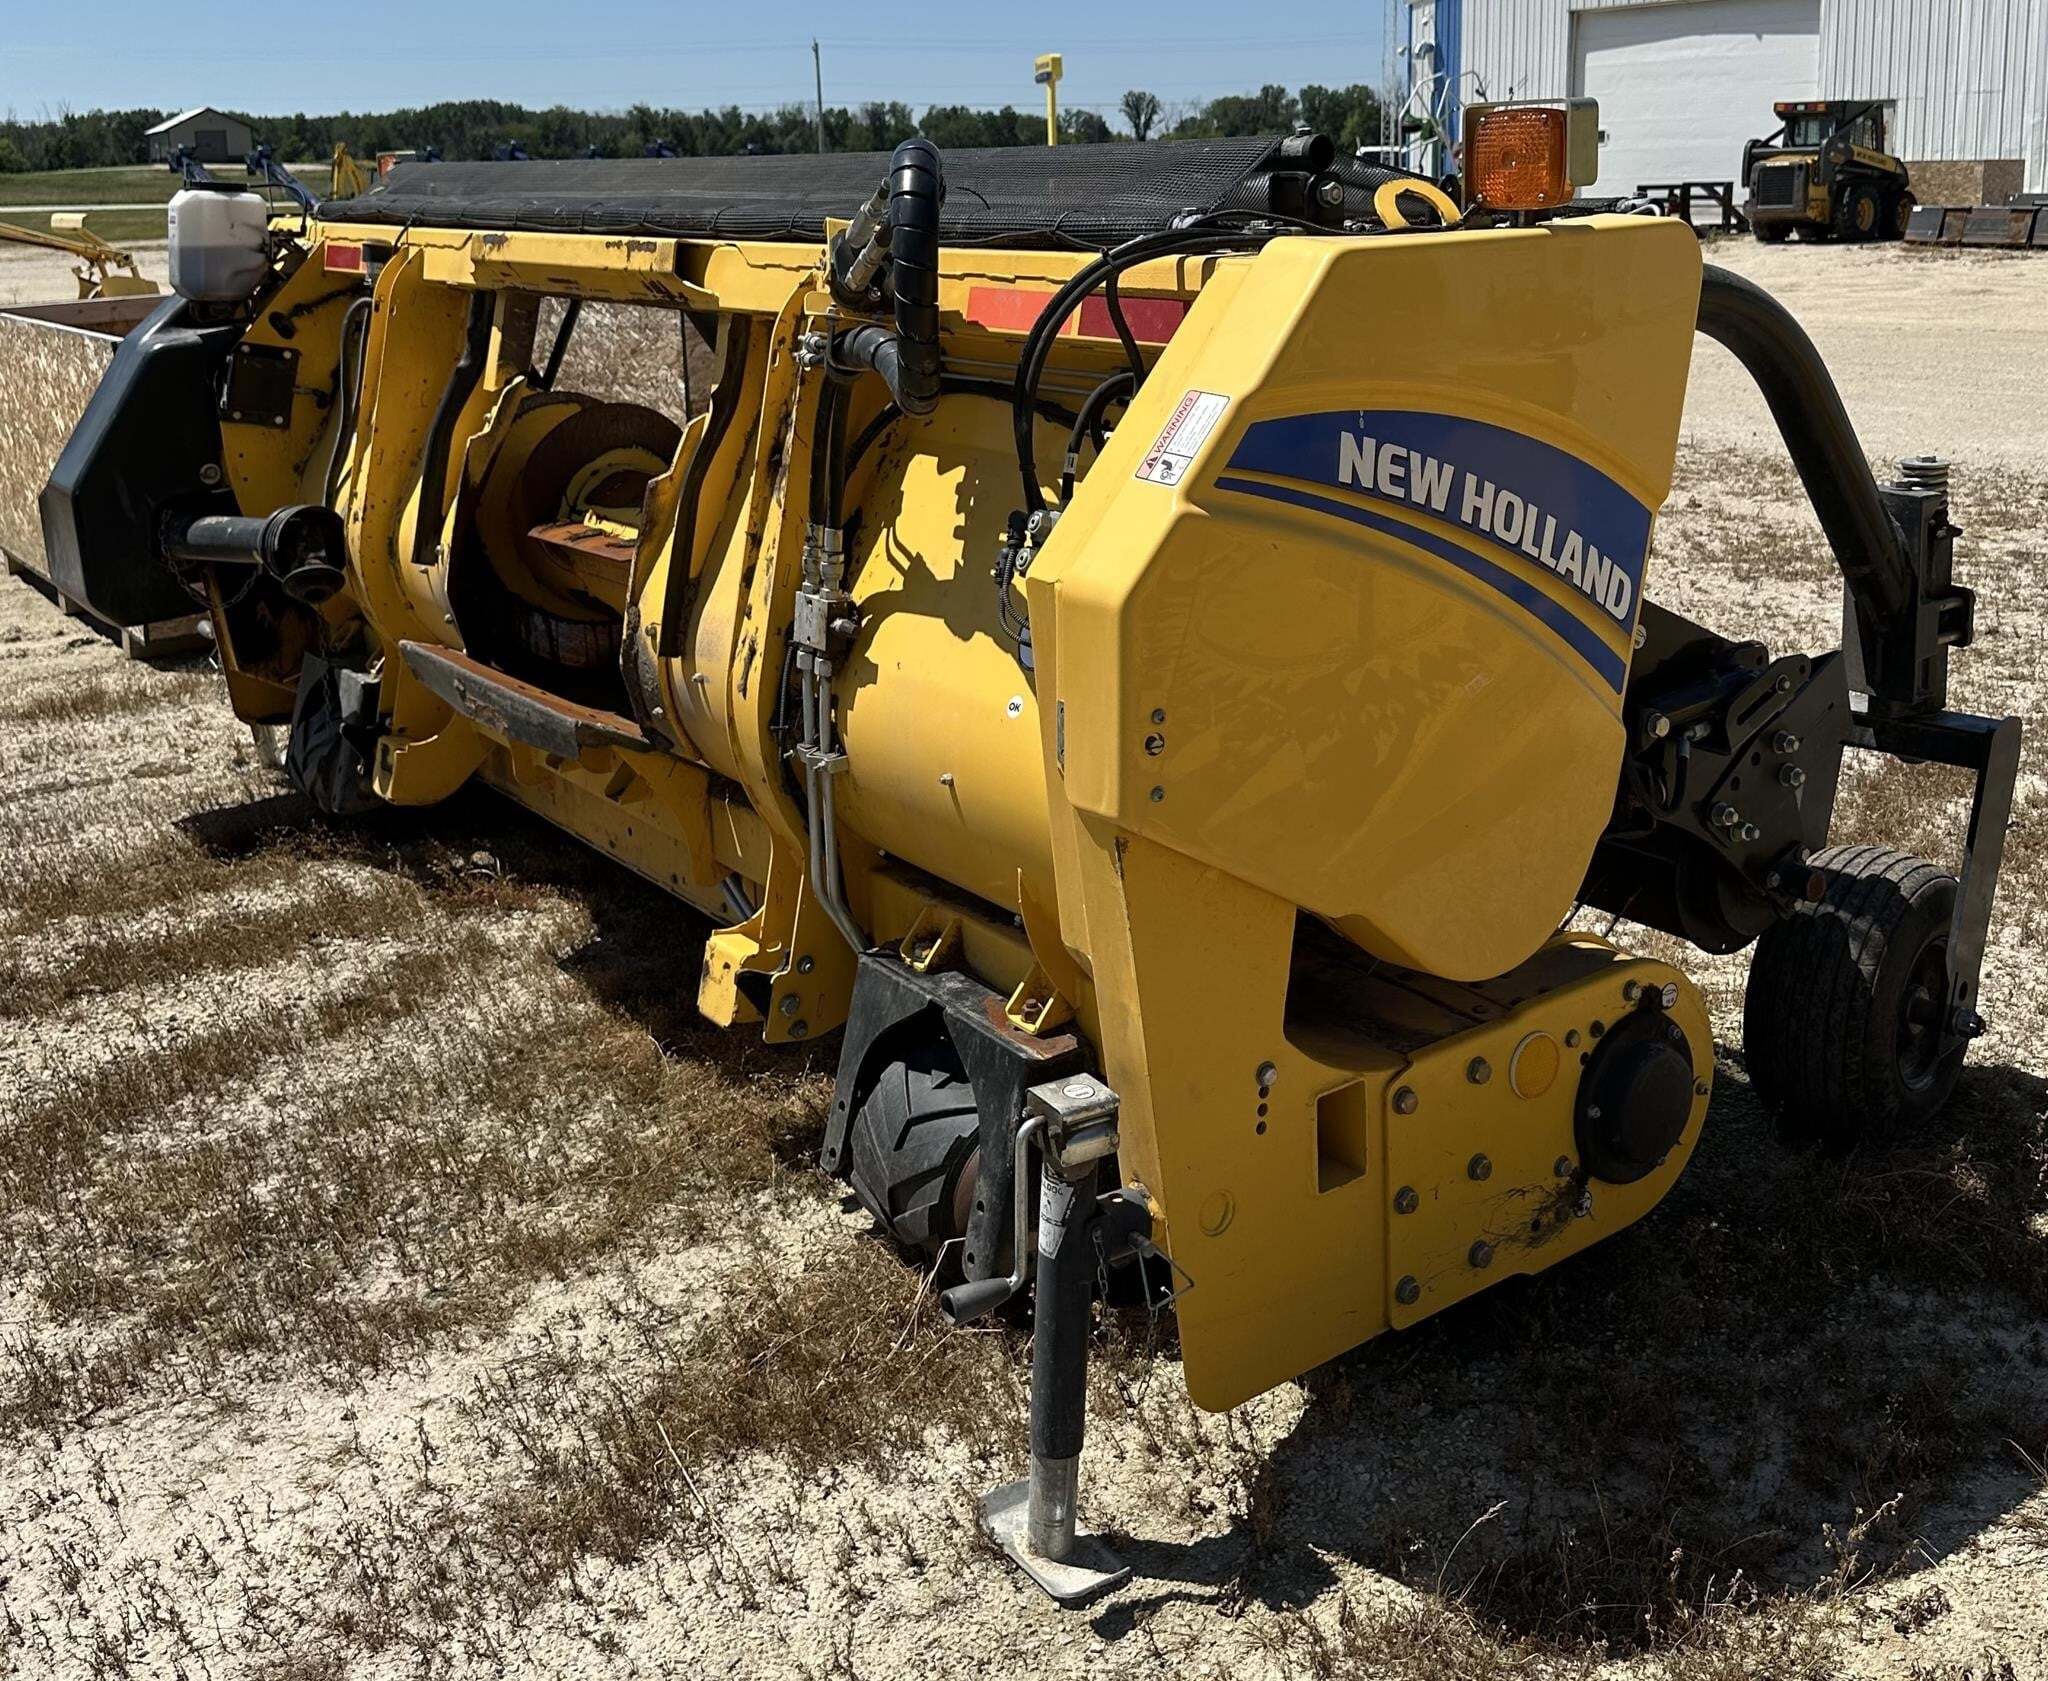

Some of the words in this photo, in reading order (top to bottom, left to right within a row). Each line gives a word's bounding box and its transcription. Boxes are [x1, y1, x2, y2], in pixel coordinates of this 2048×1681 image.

[1154, 397, 1193, 454] WARNING
[1338, 431, 1455, 512] NEW
[1460, 472, 1632, 620] HOLLAND
[1008, 702, 1021, 712] OK
